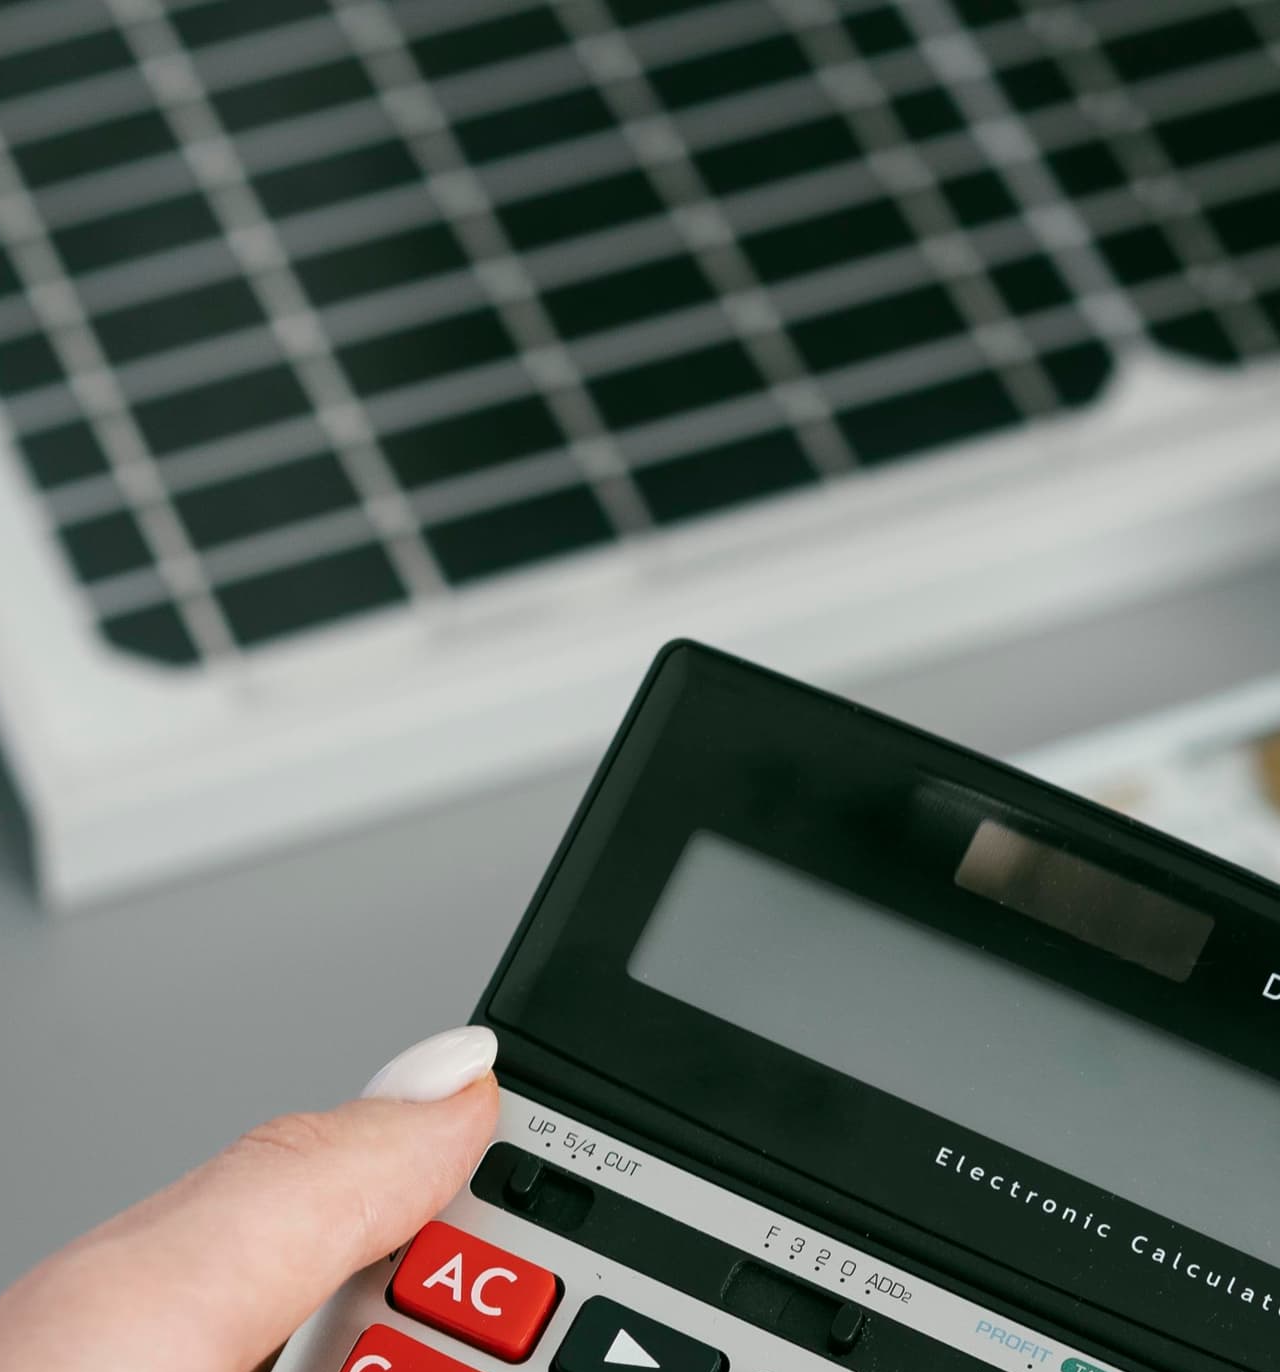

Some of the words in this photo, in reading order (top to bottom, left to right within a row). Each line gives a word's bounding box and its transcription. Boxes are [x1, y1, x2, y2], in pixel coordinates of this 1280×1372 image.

[527, 1115, 557, 1136] UP
[562, 1131, 597, 1158] 5/4
[603, 1150, 643, 1177] CUT
[934, 1146, 1112, 1238] Electronic
[765, 1224, 782, 1240] F
[789, 1236, 807, 1254] 3
[814, 1248, 832, 1267] 2
[421, 1251, 519, 1317] AC
[974, 1319, 1054, 1363] PROFIT
